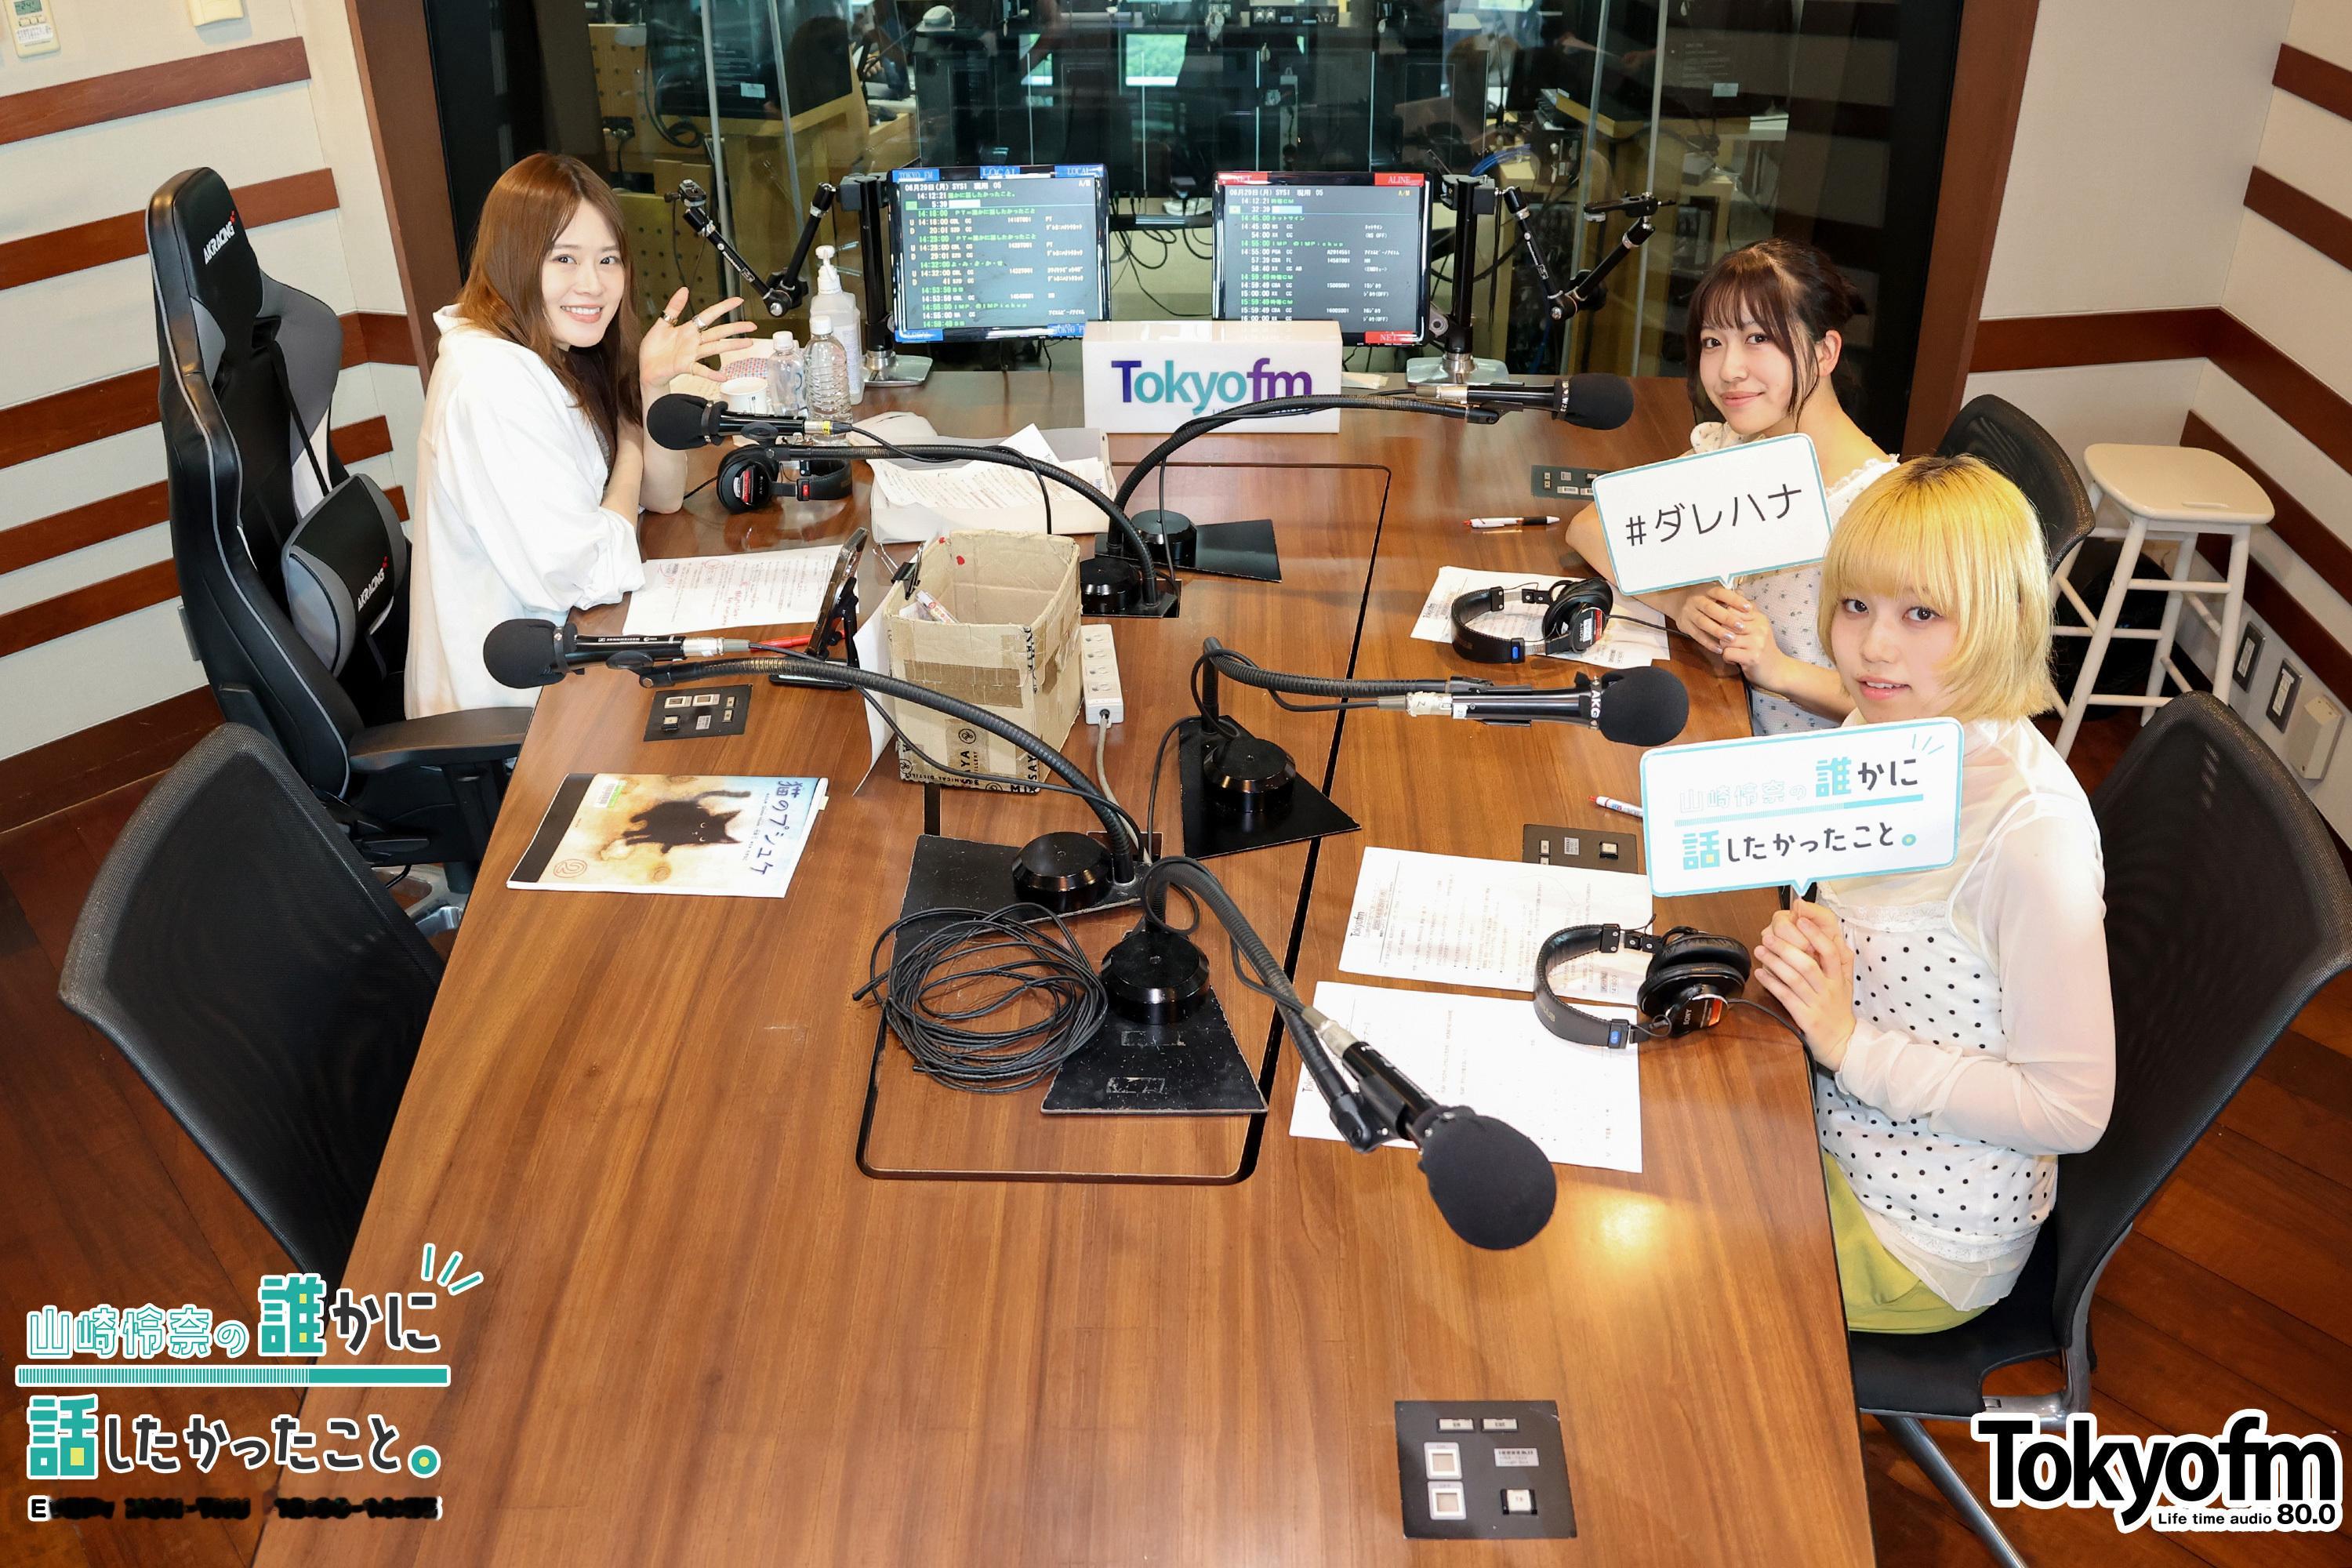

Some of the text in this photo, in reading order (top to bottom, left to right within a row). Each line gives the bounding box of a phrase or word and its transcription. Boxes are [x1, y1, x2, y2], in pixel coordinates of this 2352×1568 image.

[203, 220, 235, 265] AKRACING
[1110, 357, 1312, 416] Tokyofm
[1625, 483, 1802, 546] #ダレハナ
[358, 567, 386, 613] AKRACING
[1590, 690, 1602, 718] AKG
[1679, 756, 1918, 814] 山崎怜奈の誰かに
[1682, 822, 1918, 870] 話したかったこと。
[1682, 1008, 1693, 1025] SONY
